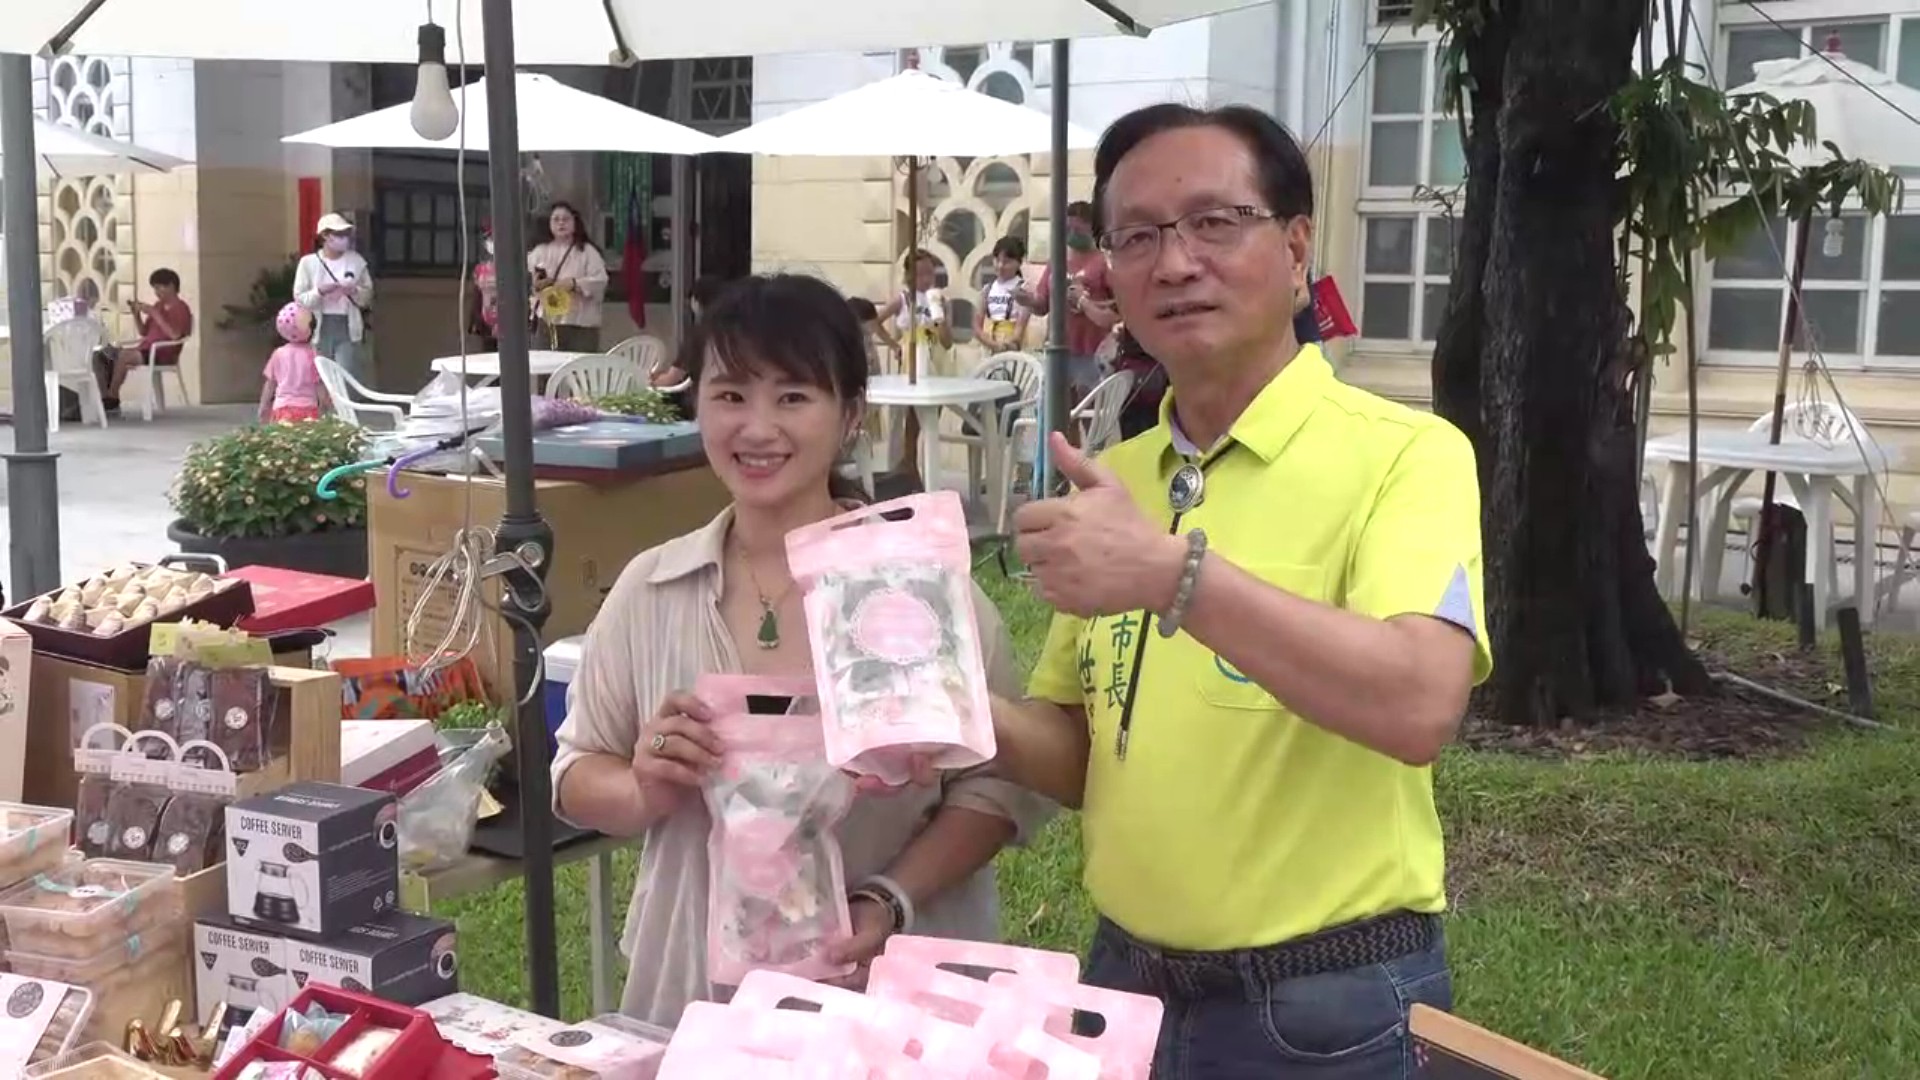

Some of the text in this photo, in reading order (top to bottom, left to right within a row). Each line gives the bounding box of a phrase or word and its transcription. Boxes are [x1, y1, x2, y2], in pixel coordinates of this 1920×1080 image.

[1103, 612, 1139, 709] 市長
[241, 815, 302, 840] COFFEE SERVER
[208, 931, 270, 955] COFFEE SERVER
[300, 948, 359, 974] COFFEE SERVER
